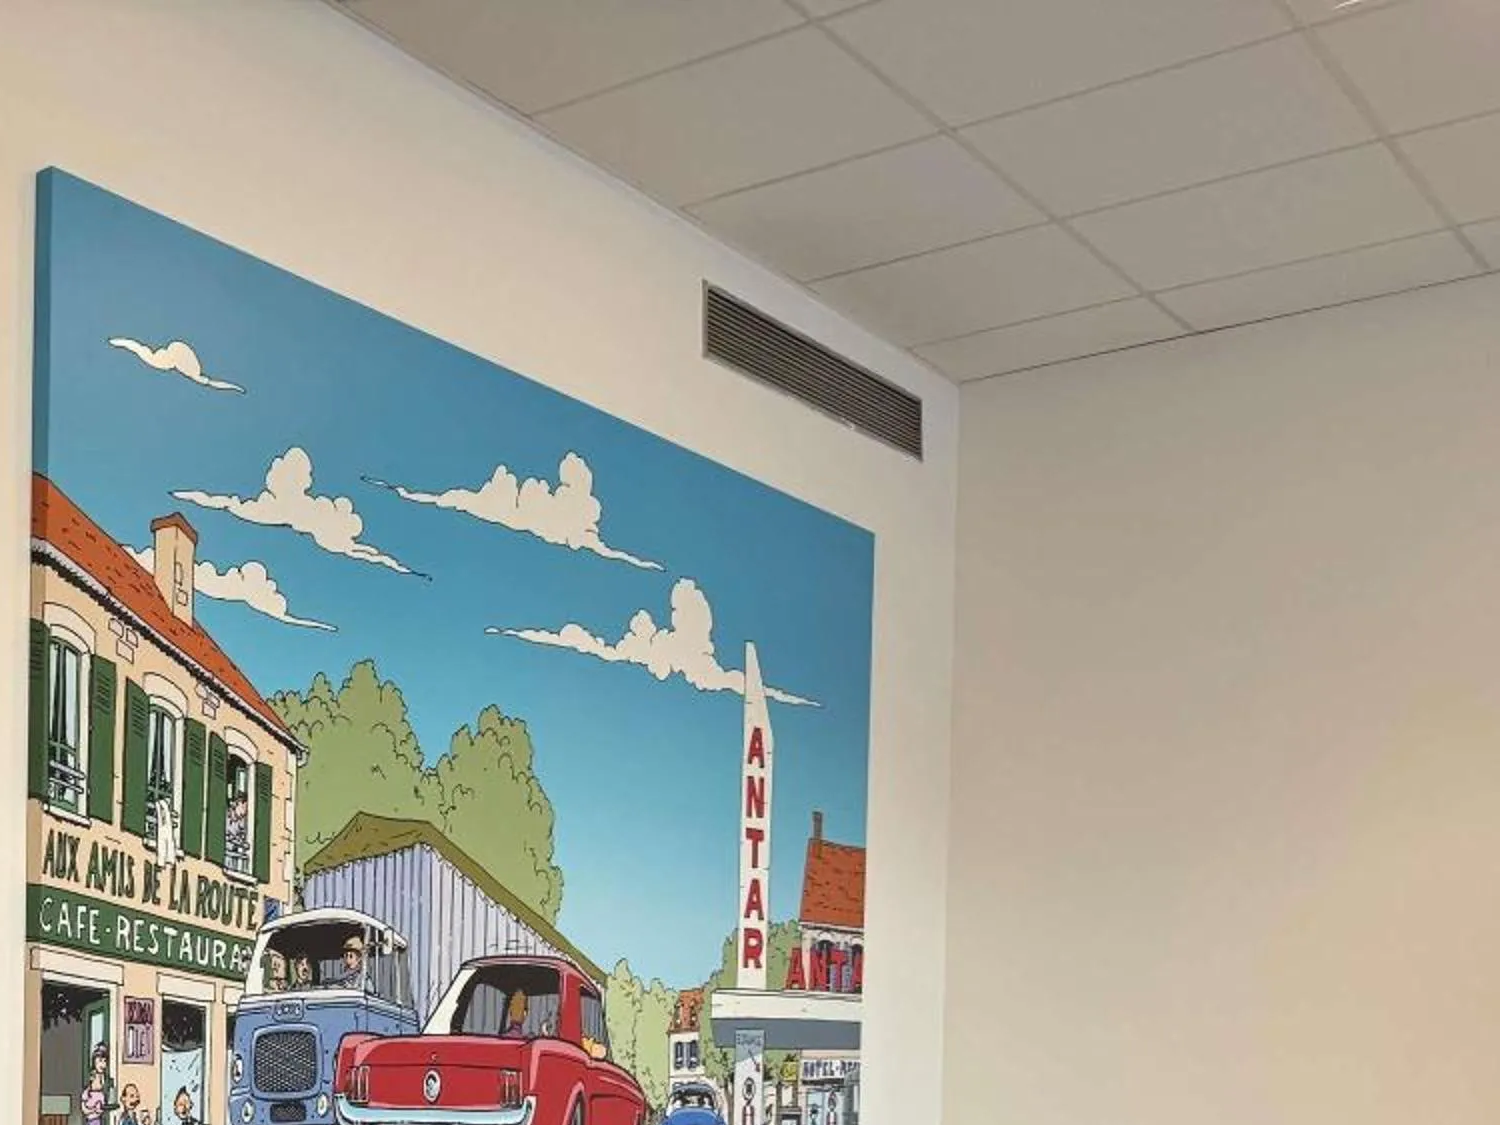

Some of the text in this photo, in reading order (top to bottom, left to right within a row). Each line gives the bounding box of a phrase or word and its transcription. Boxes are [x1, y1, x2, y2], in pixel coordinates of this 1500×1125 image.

[42, 828, 258, 931] AUX AMIS DE LA ROUTE
[743, 726, 765, 968] ANTAR
